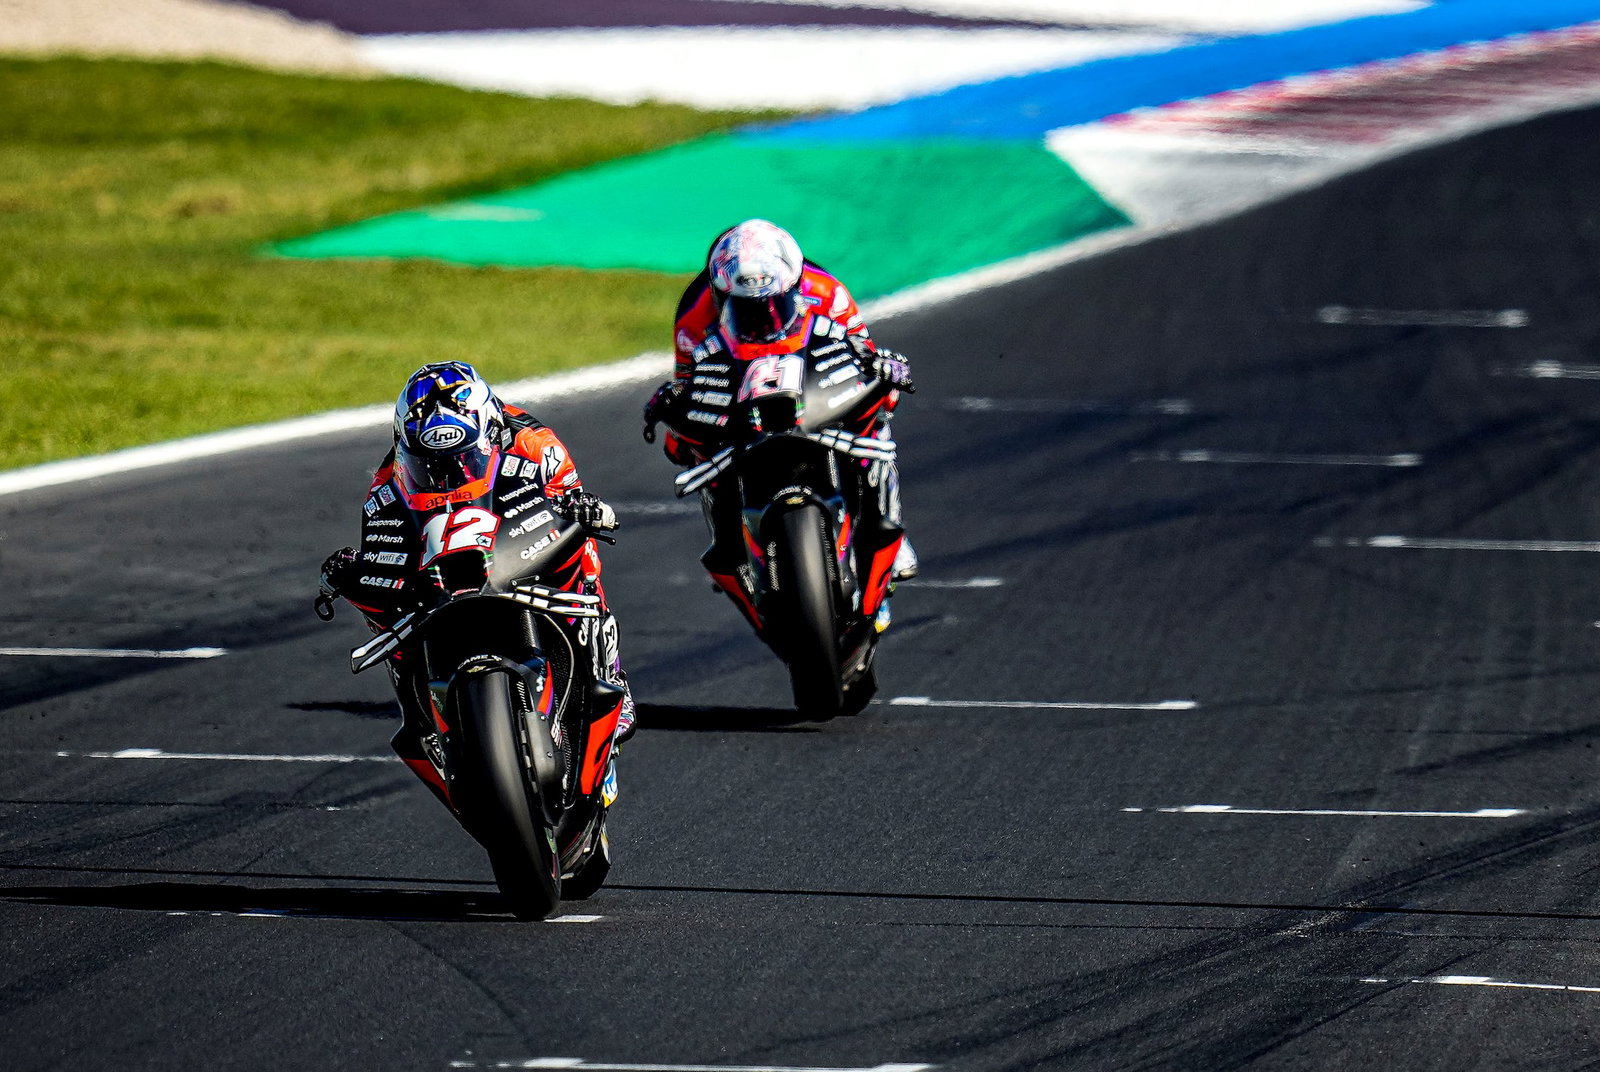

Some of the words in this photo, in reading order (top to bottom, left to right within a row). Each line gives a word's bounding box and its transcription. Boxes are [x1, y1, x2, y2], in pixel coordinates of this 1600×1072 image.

[425, 489, 473, 508] aprilia
[516, 496, 544, 512] Marsh
[509, 526, 525, 538] sky
[525, 517, 541, 529] wifi
[377, 535, 404, 543] Marsh
[419, 507, 501, 570] 12
[520, 535, 551, 560] CASE
[363, 552, 379, 562] sky
[380, 554, 395, 562] wifi
[360, 575, 392, 588] CASE
